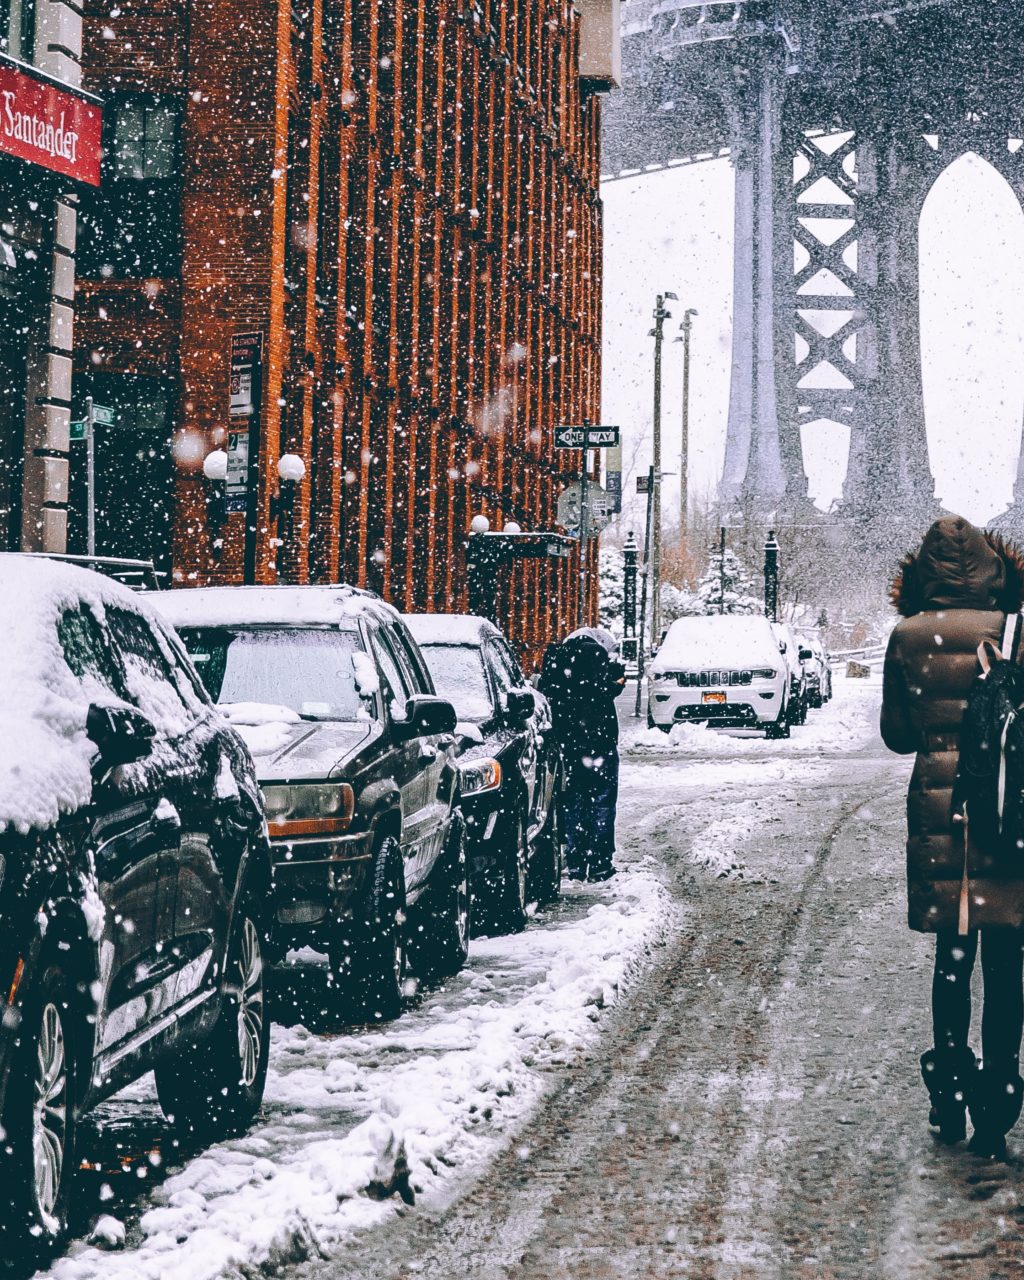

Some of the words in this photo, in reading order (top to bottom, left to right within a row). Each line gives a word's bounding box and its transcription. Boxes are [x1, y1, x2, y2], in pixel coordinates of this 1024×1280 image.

[3, 89, 79, 164] Santander
[564, 432, 583, 442] ONE
[591, 432, 611, 441] AY
